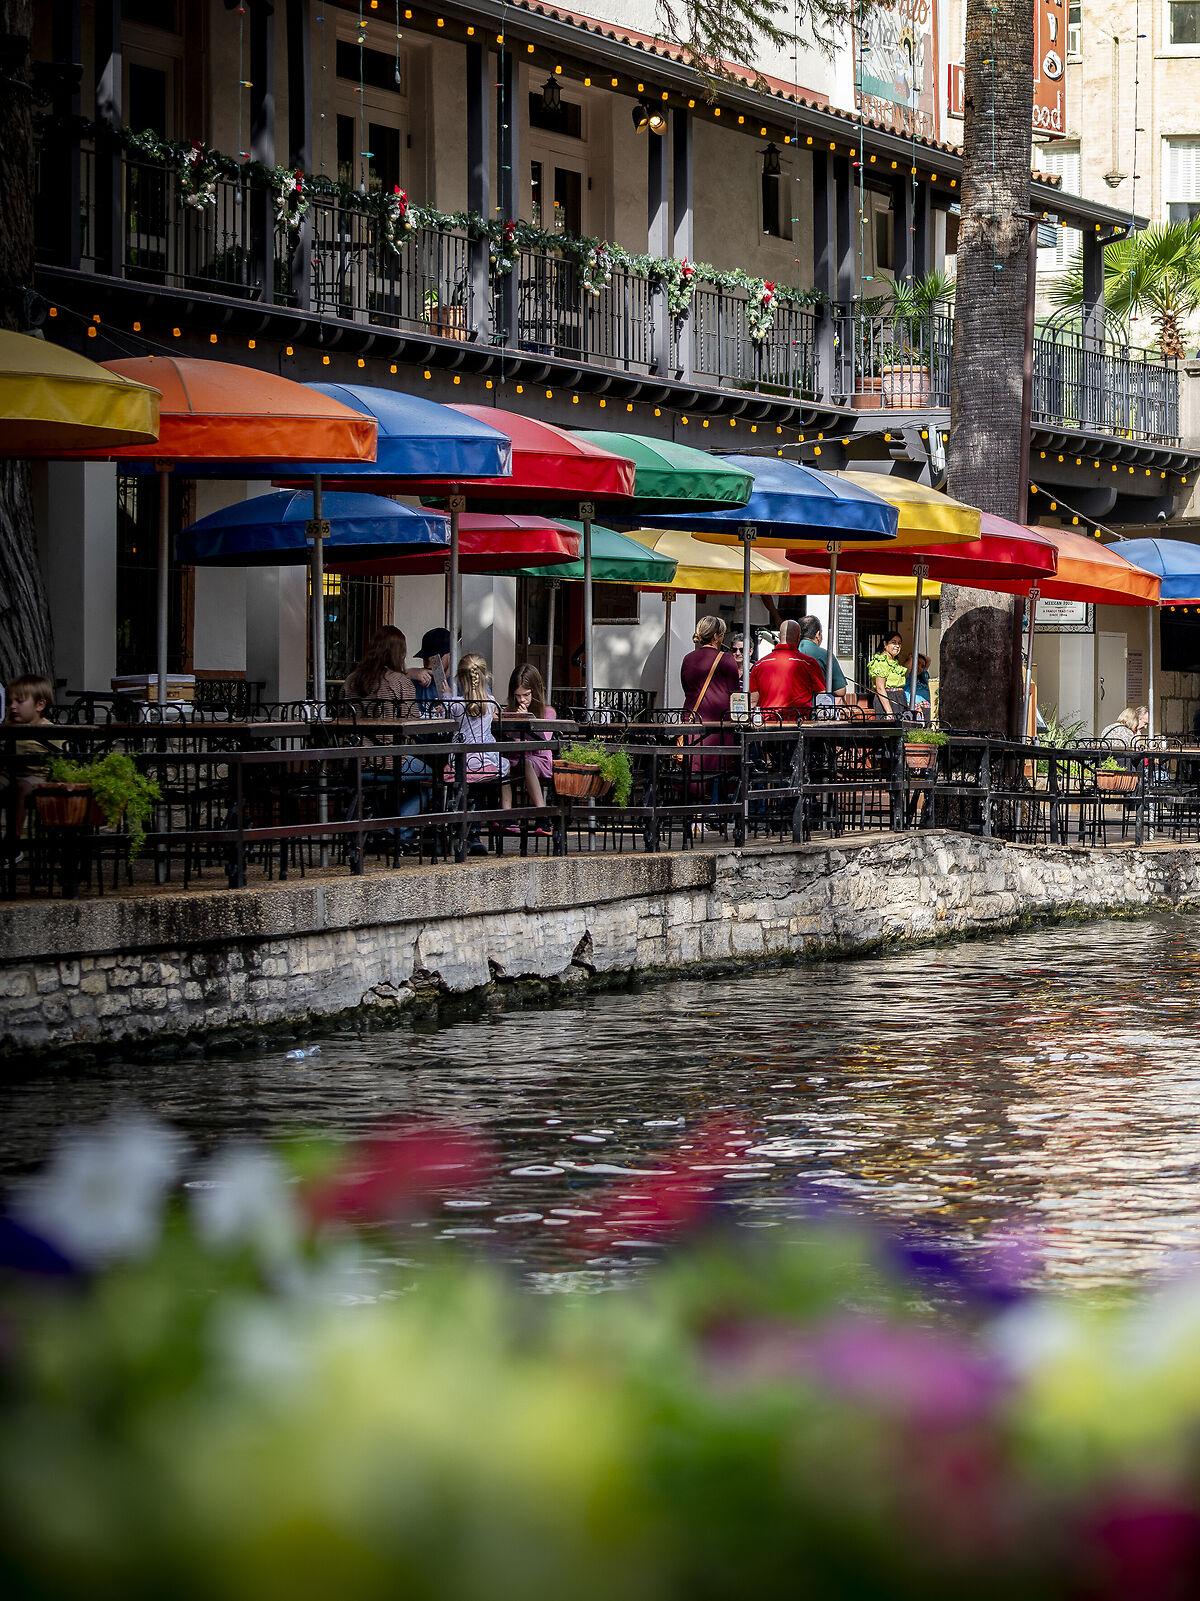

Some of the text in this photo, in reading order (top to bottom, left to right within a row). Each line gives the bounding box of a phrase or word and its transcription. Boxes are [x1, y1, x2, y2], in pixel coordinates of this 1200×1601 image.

[1032, 90, 1061, 129] ood
[580, 504, 593, 514] 63
[1029, 590, 1040, 600] 57
